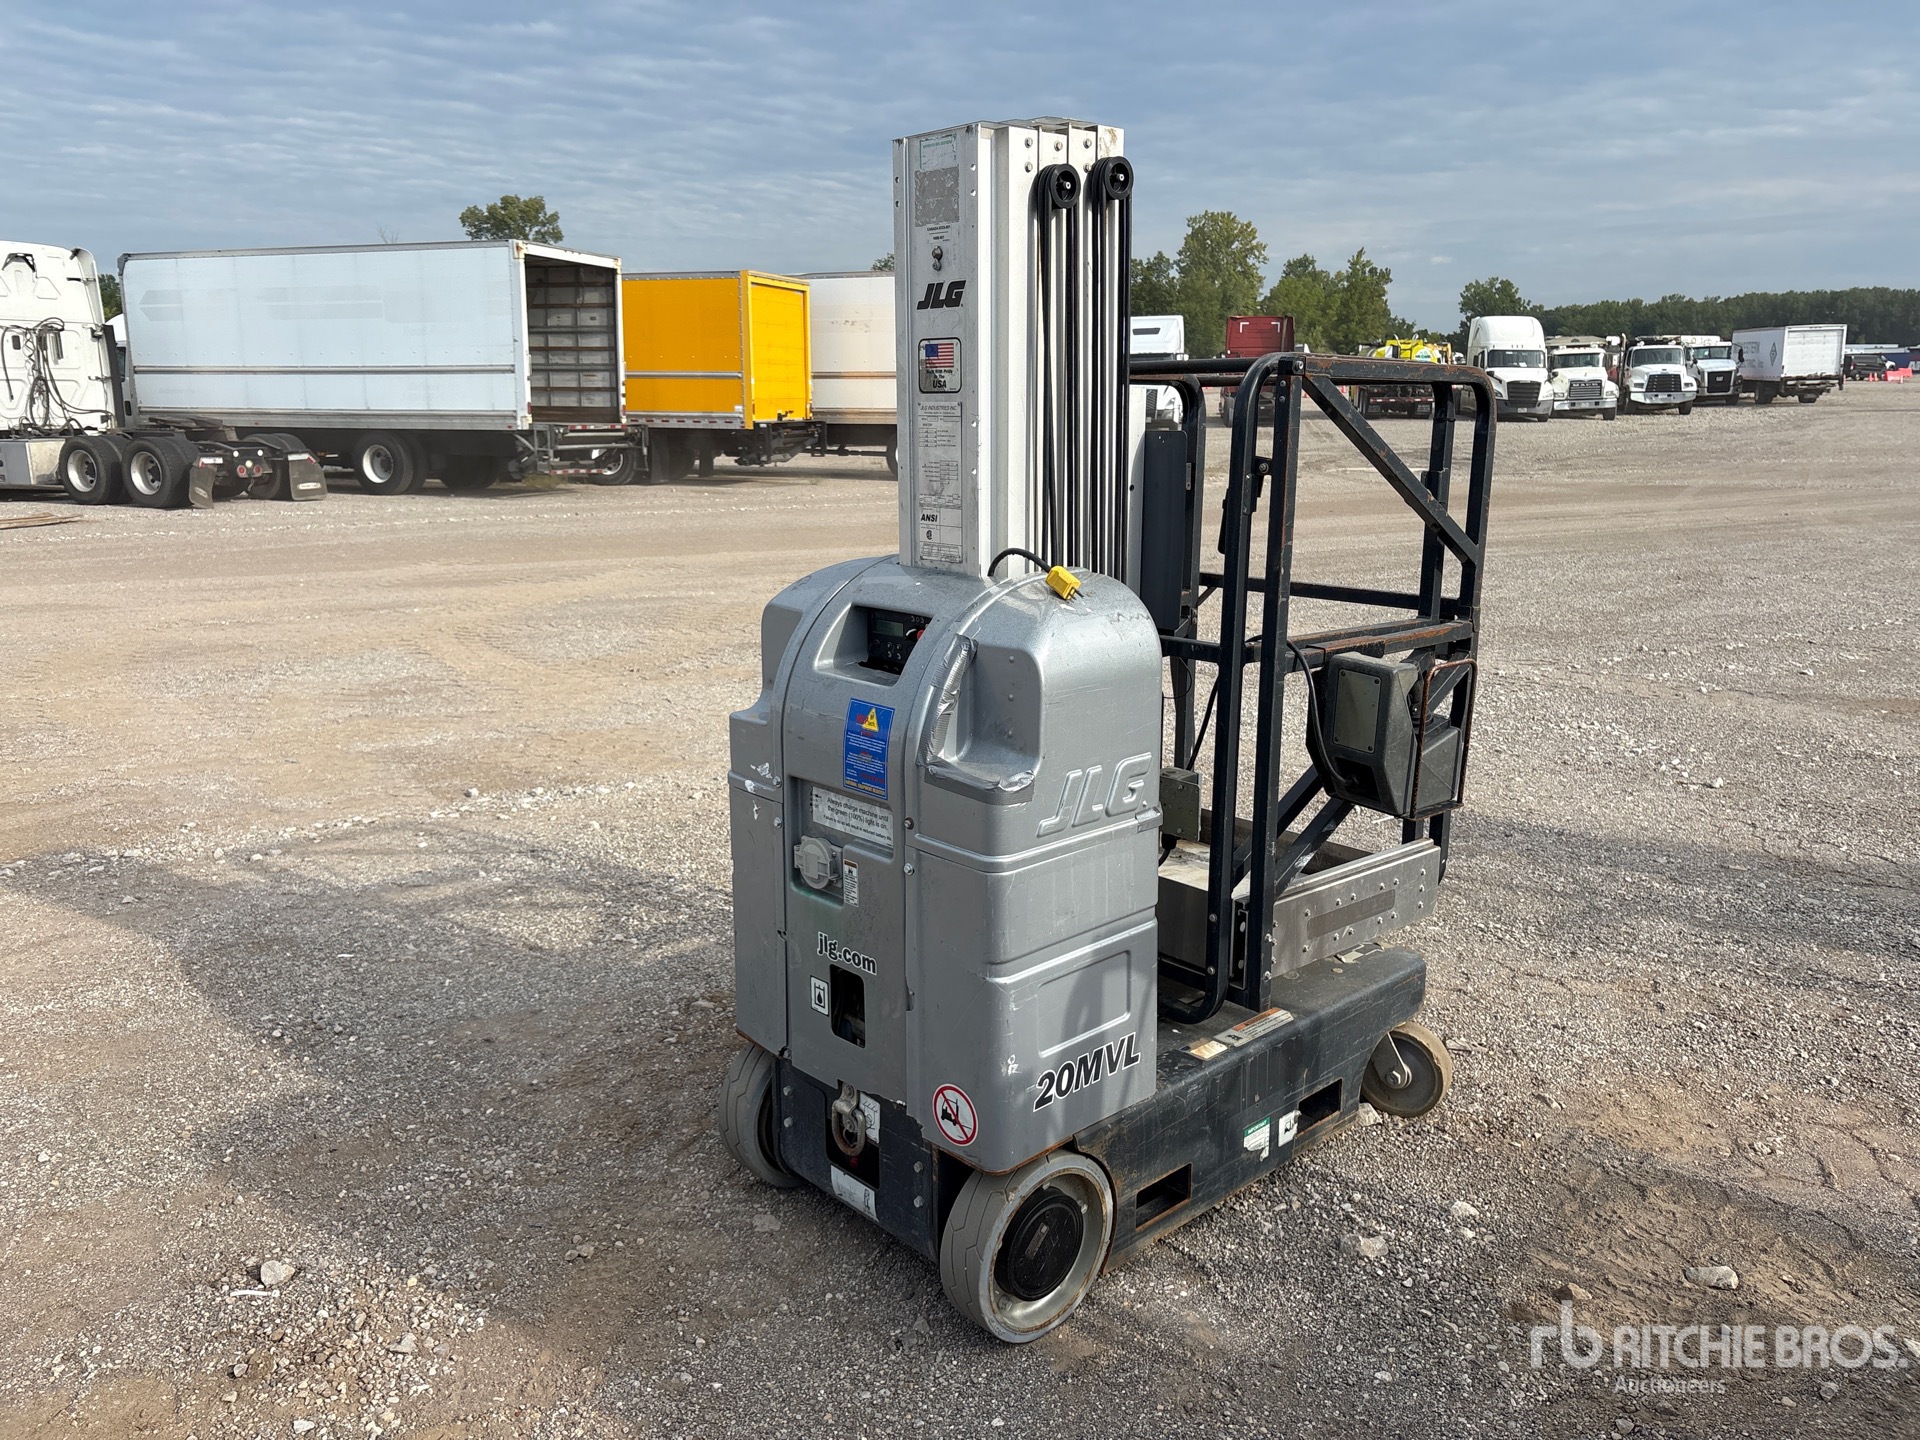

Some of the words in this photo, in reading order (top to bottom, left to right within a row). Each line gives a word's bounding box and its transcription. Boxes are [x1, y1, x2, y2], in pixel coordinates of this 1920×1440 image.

[917, 280, 967, 310] JLG
[932, 380, 947, 388] USA
[920, 513, 938, 522] ANSI
[1036, 752, 1152, 838] JLG
[827, 797, 842, 807] Always
[843, 802, 858, 813] charge
[859, 808, 878, 818] machine
[879, 814, 889, 822] until
[827, 805, 835, 813] the
[834, 808, 848, 817] green
[848, 811, 865, 823] (100%)
[865, 817, 875, 826] light
[818, 932, 877, 975] jlg.com
[1033, 1032, 1141, 1112] 20MVL
